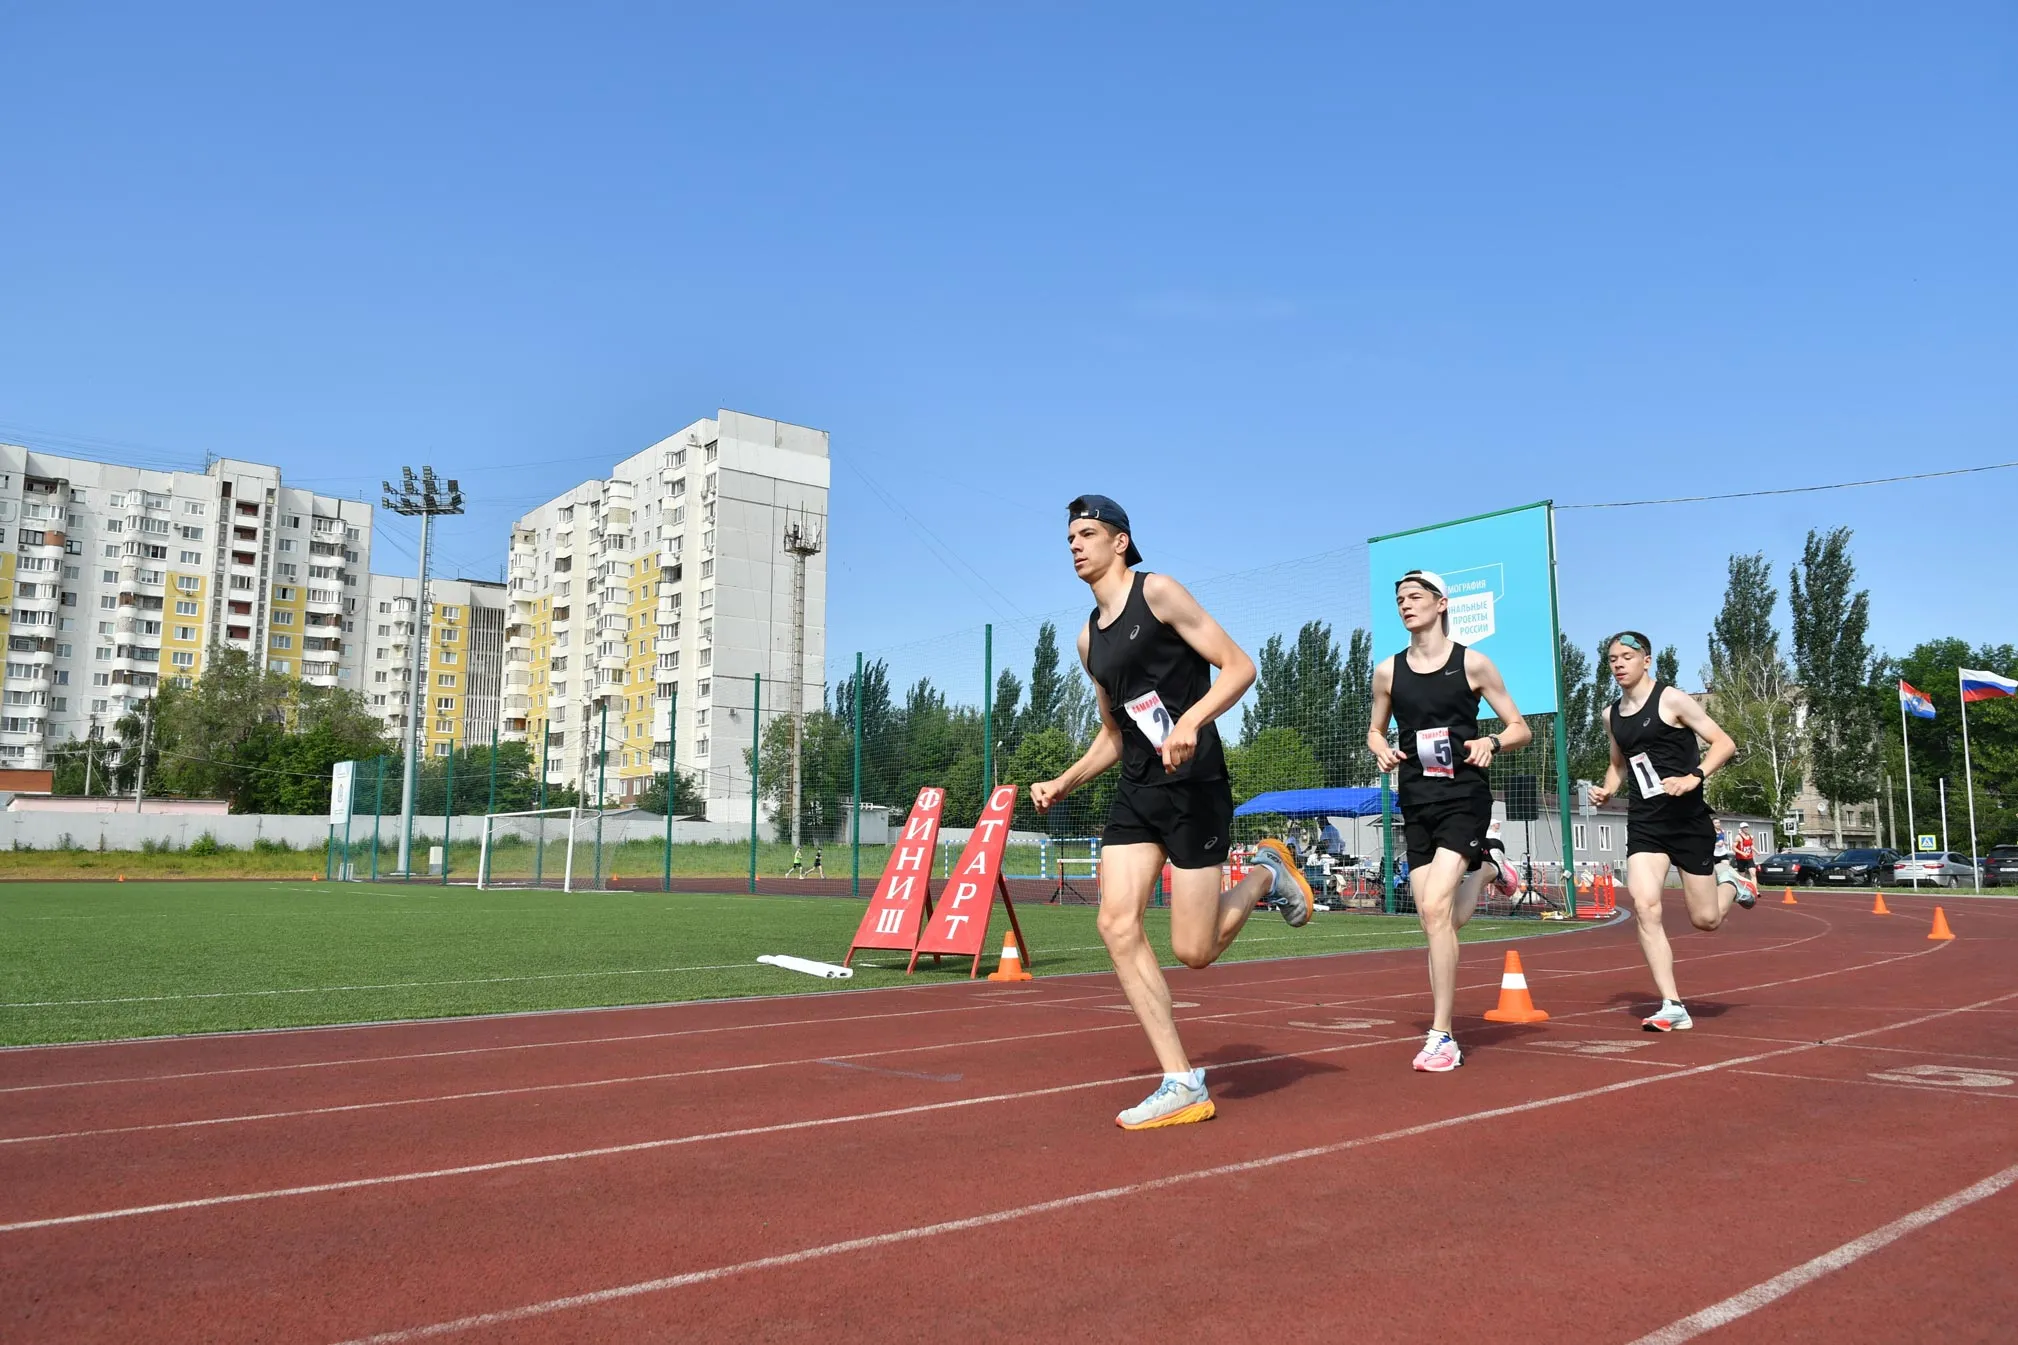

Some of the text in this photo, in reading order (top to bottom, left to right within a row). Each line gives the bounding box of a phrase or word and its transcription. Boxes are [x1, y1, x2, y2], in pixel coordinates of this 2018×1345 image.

[1446, 580, 1486, 594] МОГРАФИЯ
[1453, 612, 1488, 625] ПРОЕКТЫ
[1460, 623, 1489, 636] РОССИИ
[1434, 739, 1451, 766] 5
[1636, 762, 1654, 789] 1
[875, 788, 940, 934] ФИНИШ
[945, 788, 1013, 940] СТАРТ
[1866, 1064, 2018, 1087] 5
